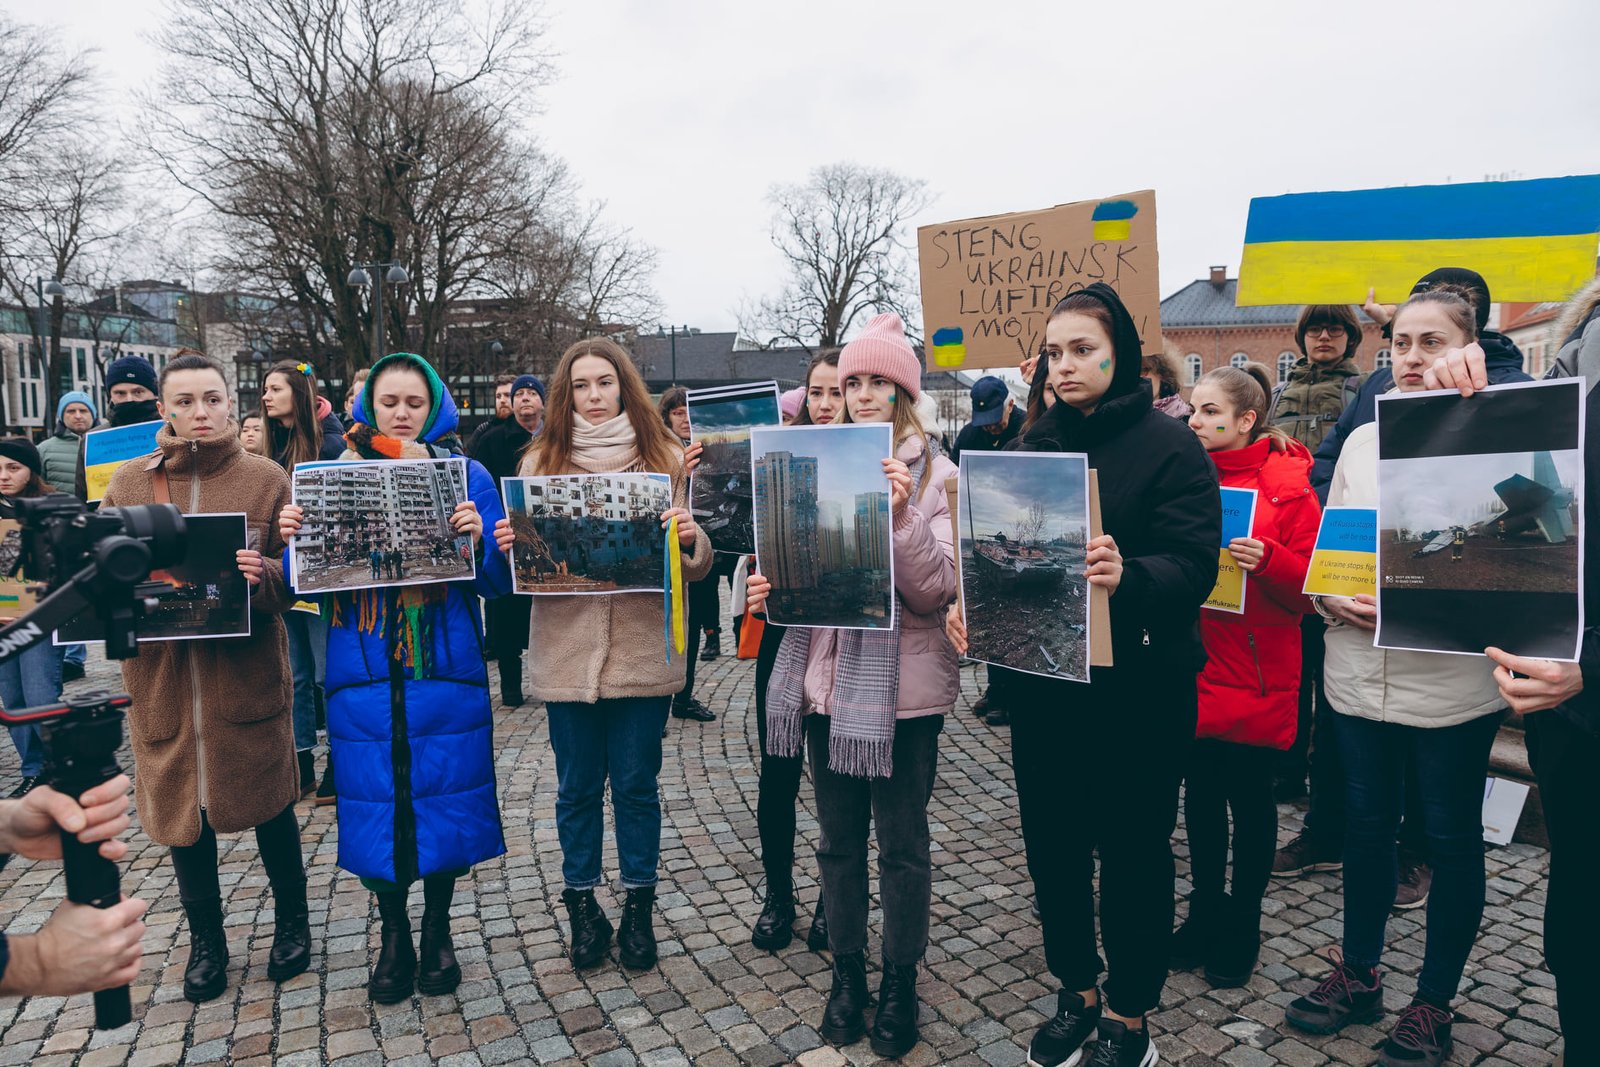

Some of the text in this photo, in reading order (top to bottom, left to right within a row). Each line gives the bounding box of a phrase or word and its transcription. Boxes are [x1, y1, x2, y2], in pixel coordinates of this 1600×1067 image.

[932, 222, 1041, 269] STENG
[966, 243, 1138, 285] UKRAINSK
[1222, 508, 1240, 517] ere
[1219, 564, 1235, 573] ere
[1324, 561, 1346, 569] Ukraine
[1346, 563, 1364, 571] stops
[1350, 576, 1369, 584] more
